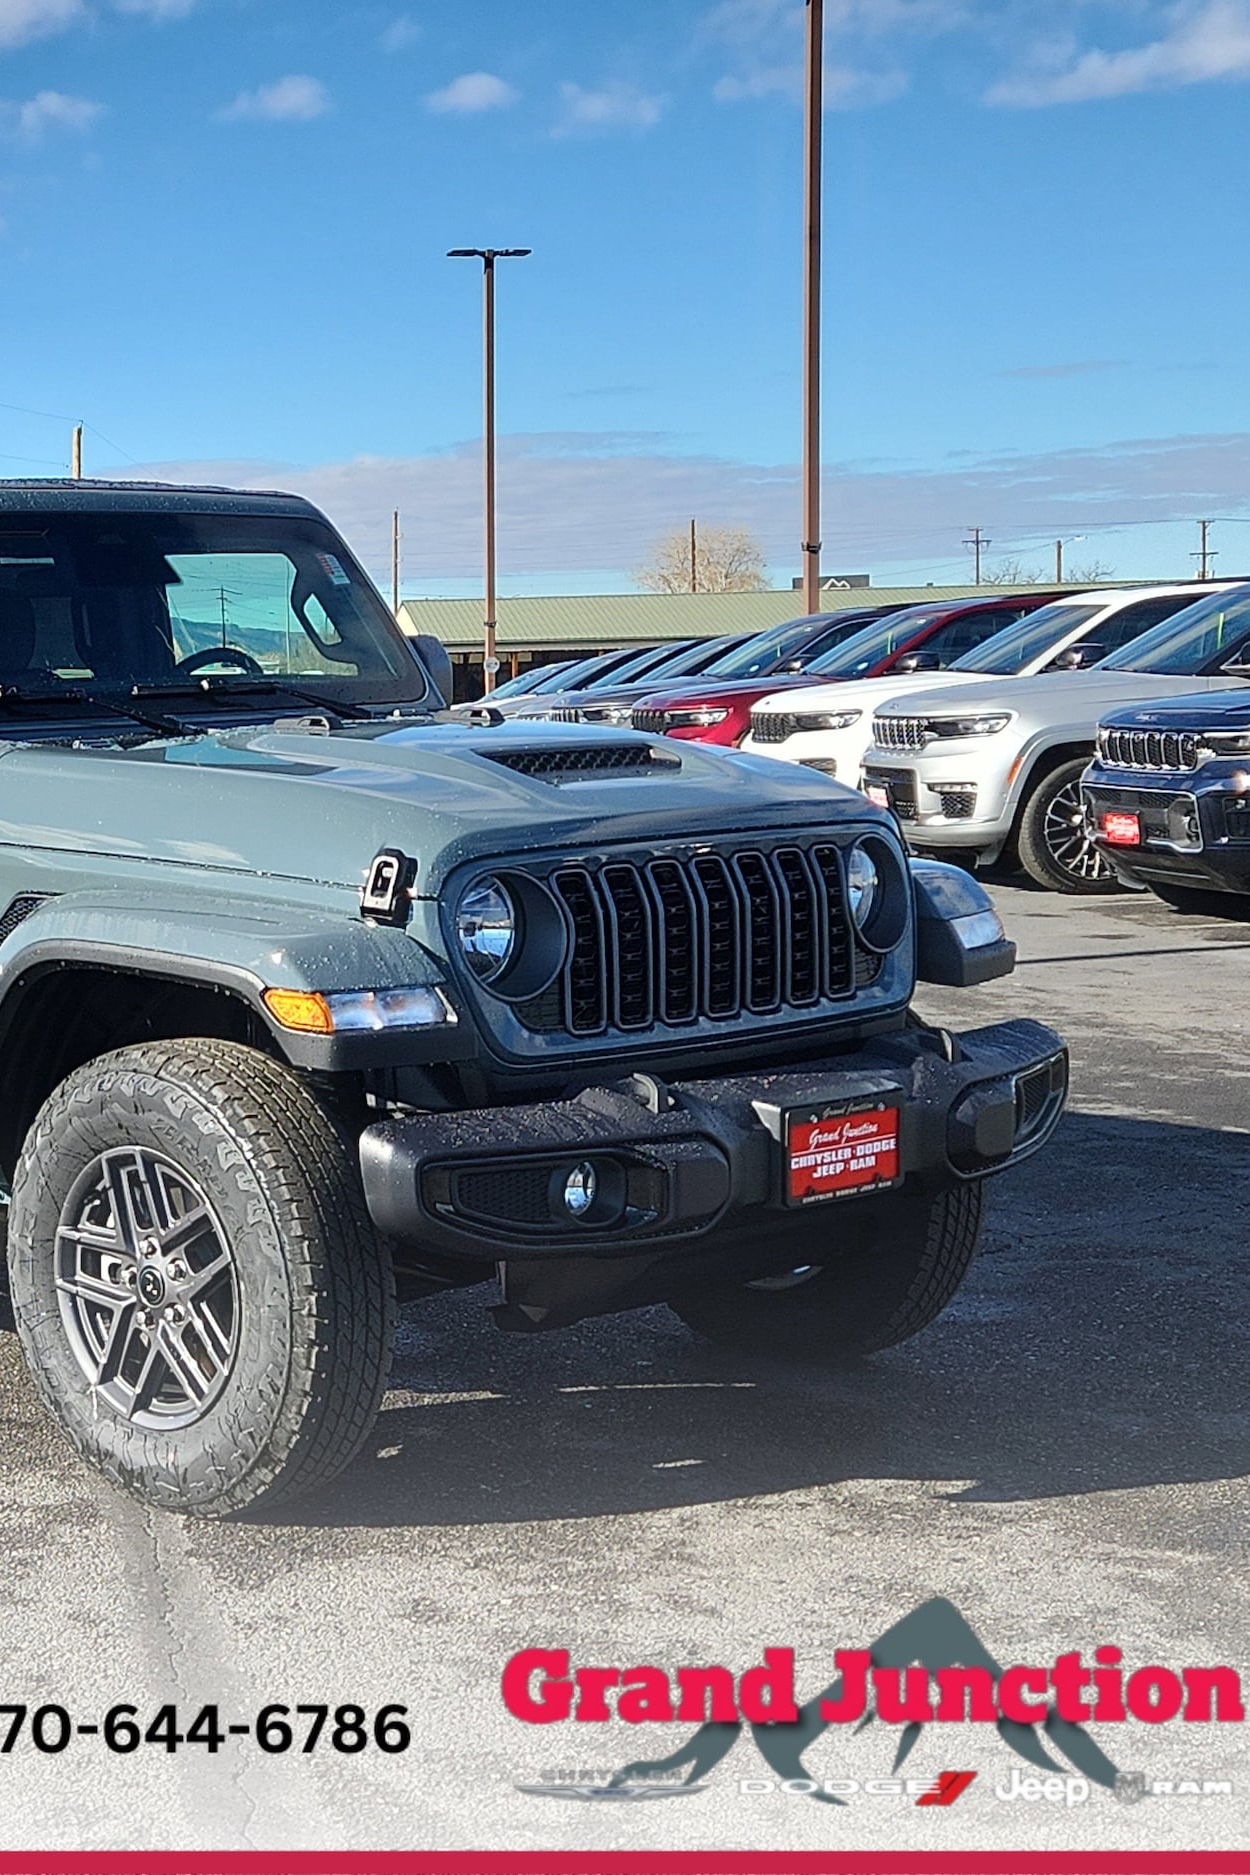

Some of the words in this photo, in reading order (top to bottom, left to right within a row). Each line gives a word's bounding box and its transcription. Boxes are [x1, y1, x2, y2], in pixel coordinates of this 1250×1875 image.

[809, 1126, 842, 1152] Grand
[841, 1121, 879, 1145] Junction
[791, 1149, 851, 1169] CHRYSLER
[857, 1139, 896, 1155] DODGE
[813, 1162, 844, 1178] JEEP
[850, 1157, 875, 1172] RAM
